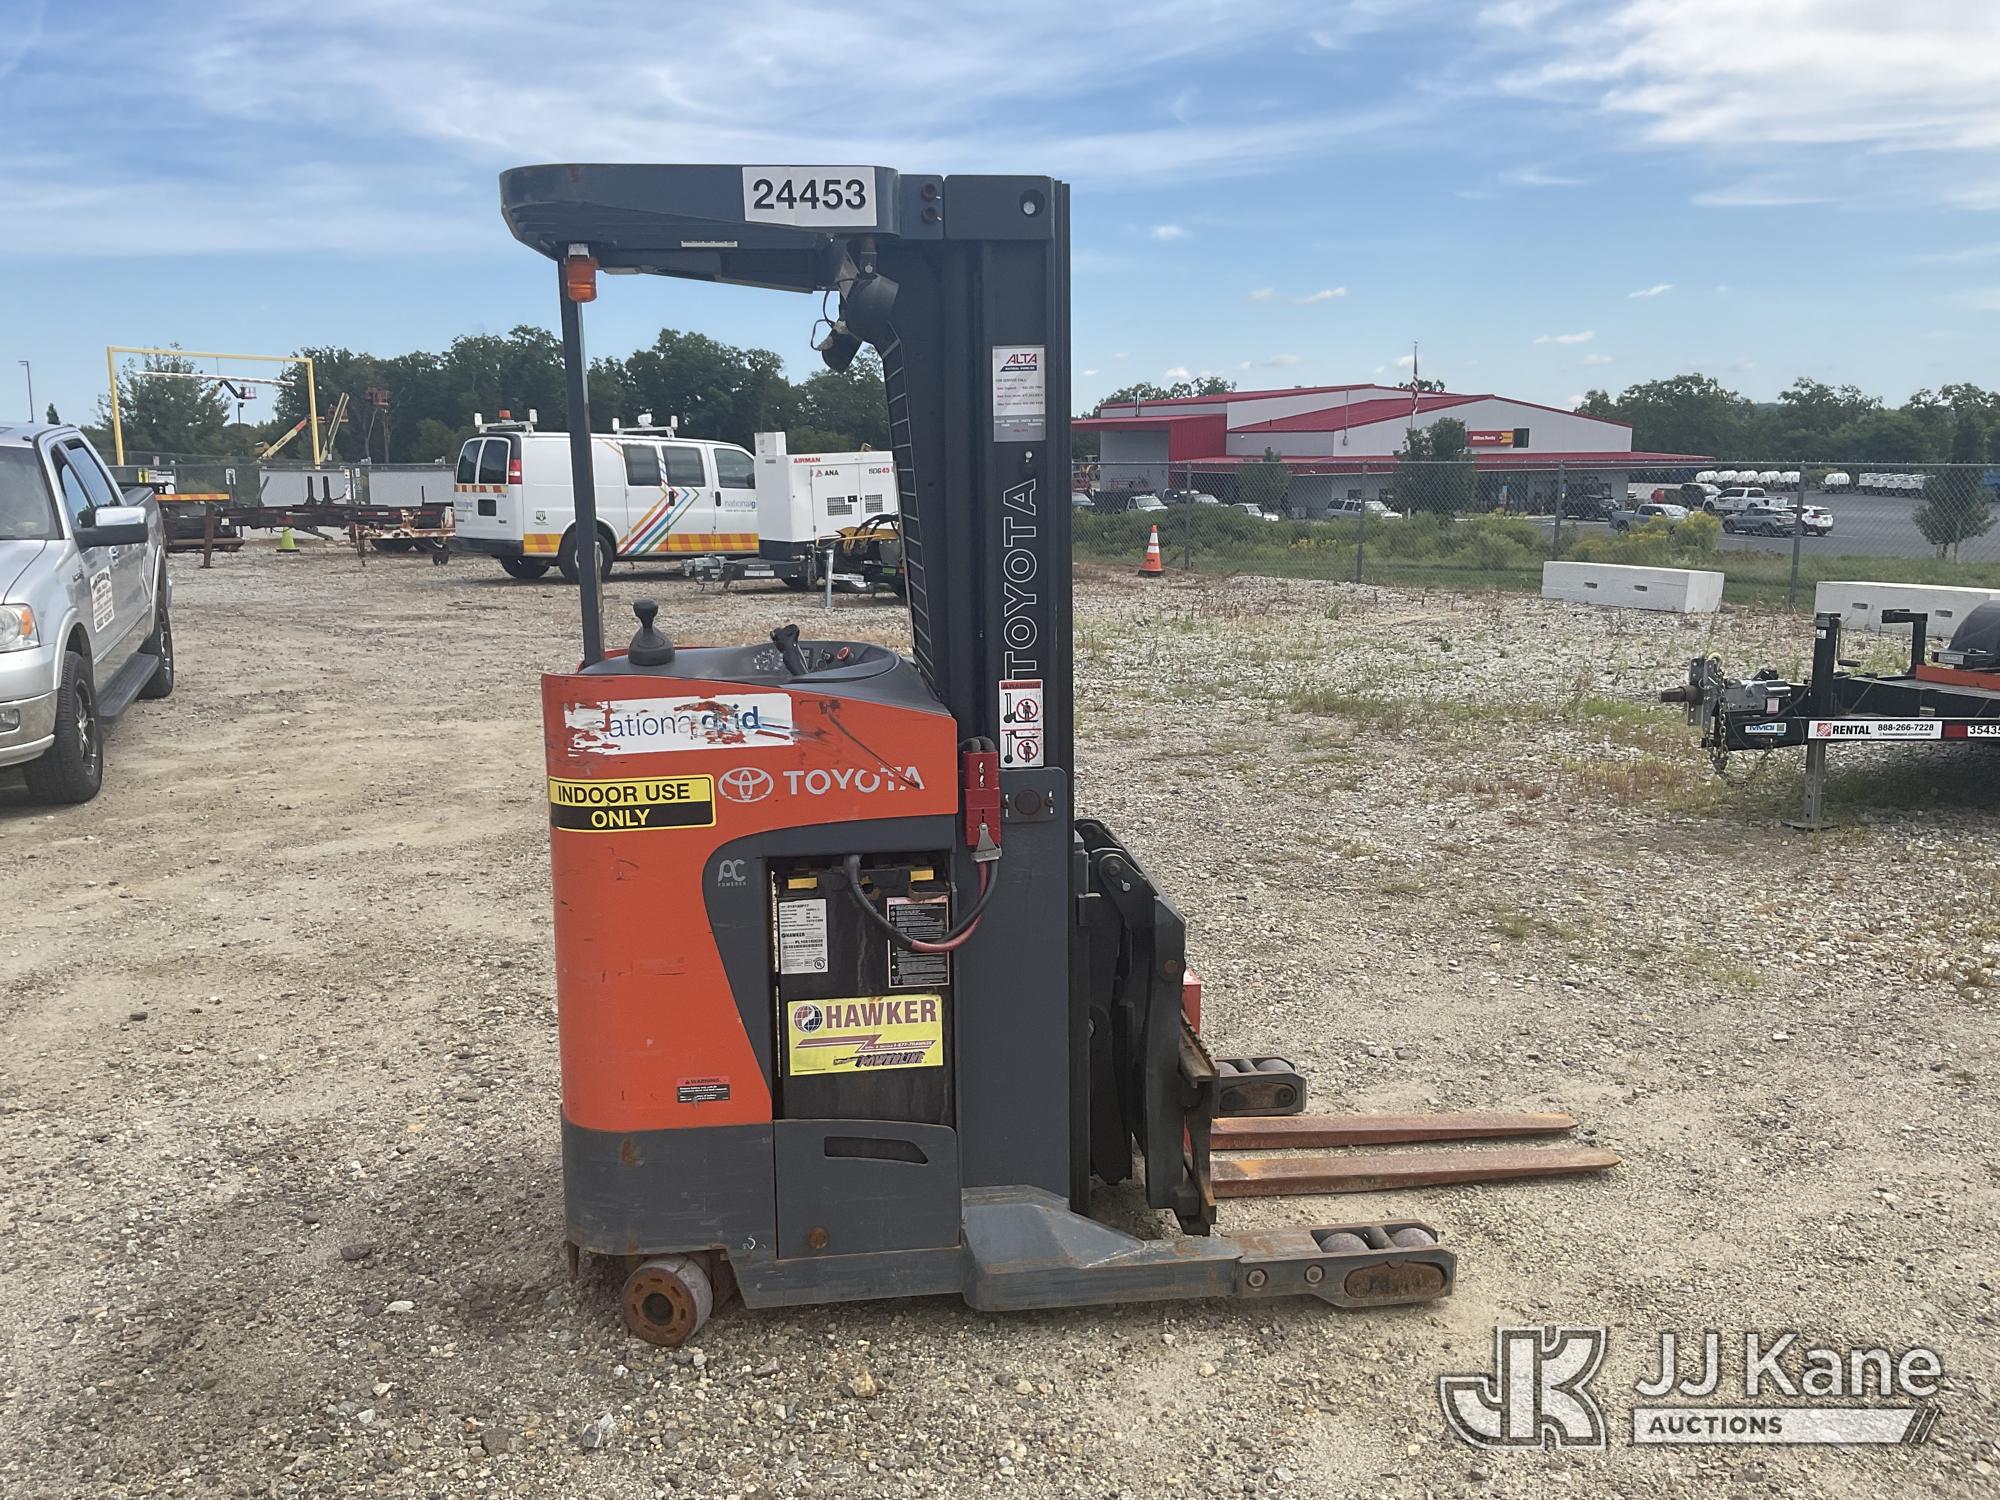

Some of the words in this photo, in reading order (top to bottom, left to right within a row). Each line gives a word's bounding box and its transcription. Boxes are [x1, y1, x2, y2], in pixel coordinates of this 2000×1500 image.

[753, 178, 867, 210] 24453
[1006, 353, 1037, 364] ALTA
[1003, 478, 1038, 680] TOYOTA
[1832, 725, 1871, 734] RENTAL
[1877, 723, 1934, 731] 888-266-7228
[782, 766, 925, 795] TOYOTA
[558, 785, 638, 804] INDOOR
[645, 783, 690, 801] USE
[591, 808, 650, 828] ONLY
[717, 859, 747, 882] AC
[826, 999, 937, 1029] HAWKER
